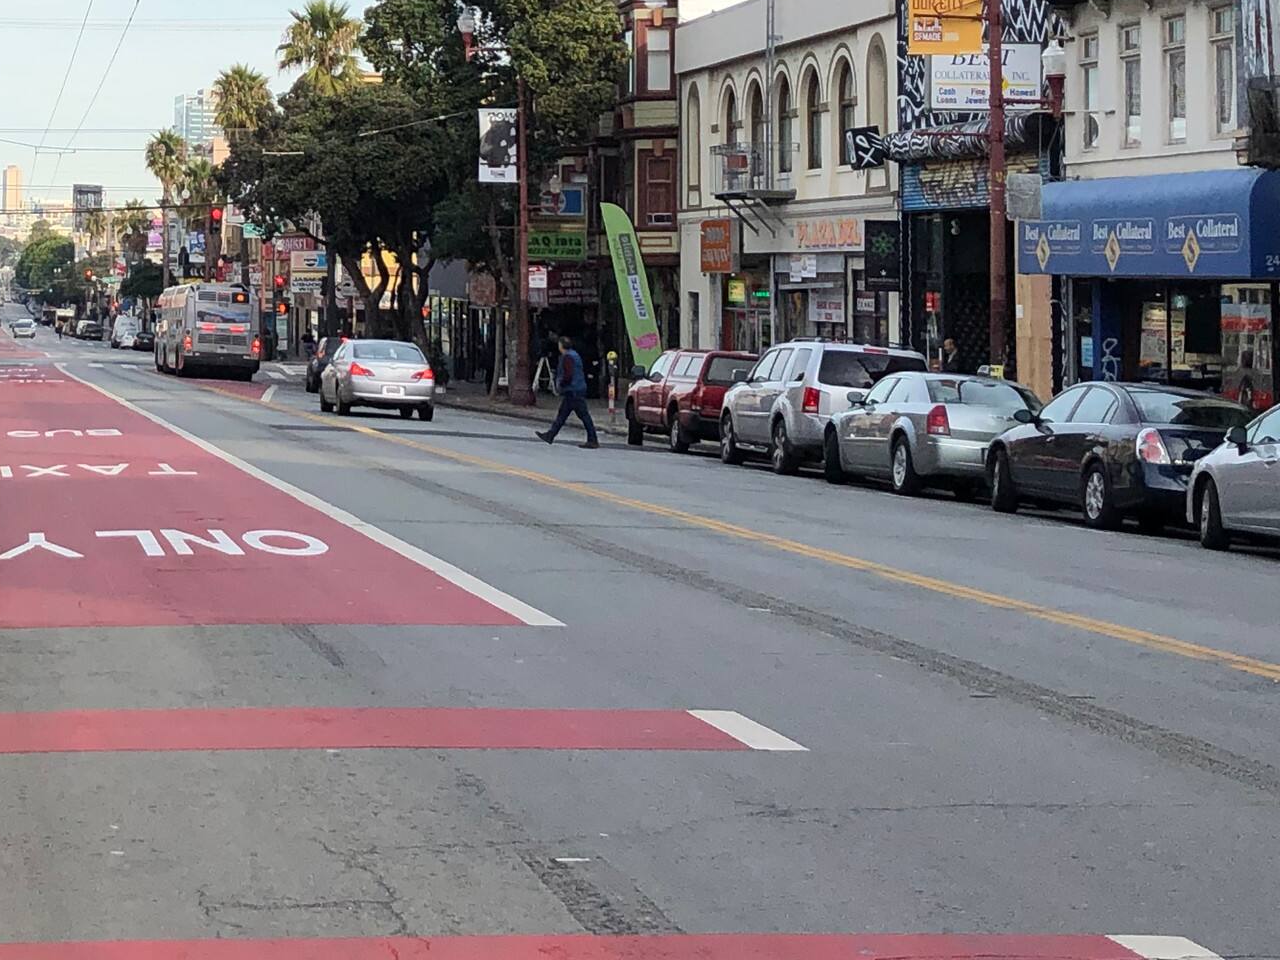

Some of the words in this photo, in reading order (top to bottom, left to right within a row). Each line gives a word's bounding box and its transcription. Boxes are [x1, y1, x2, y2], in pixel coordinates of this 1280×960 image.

[951, 49, 1015, 66] BET
[935, 71, 989, 80] COLLATERA
[938, 87, 956, 96] Cash
[1025, 224, 1040, 240] Best
[1047, 223, 1081, 240] Collateral
[1093, 224, 1108, 239] Best
[1116, 222, 1152, 239] Collateral
[1168, 220, 1185, 238] Best
[1196, 218, 1238, 238] Collateral
[0, 463, 198, 478] TAXI
